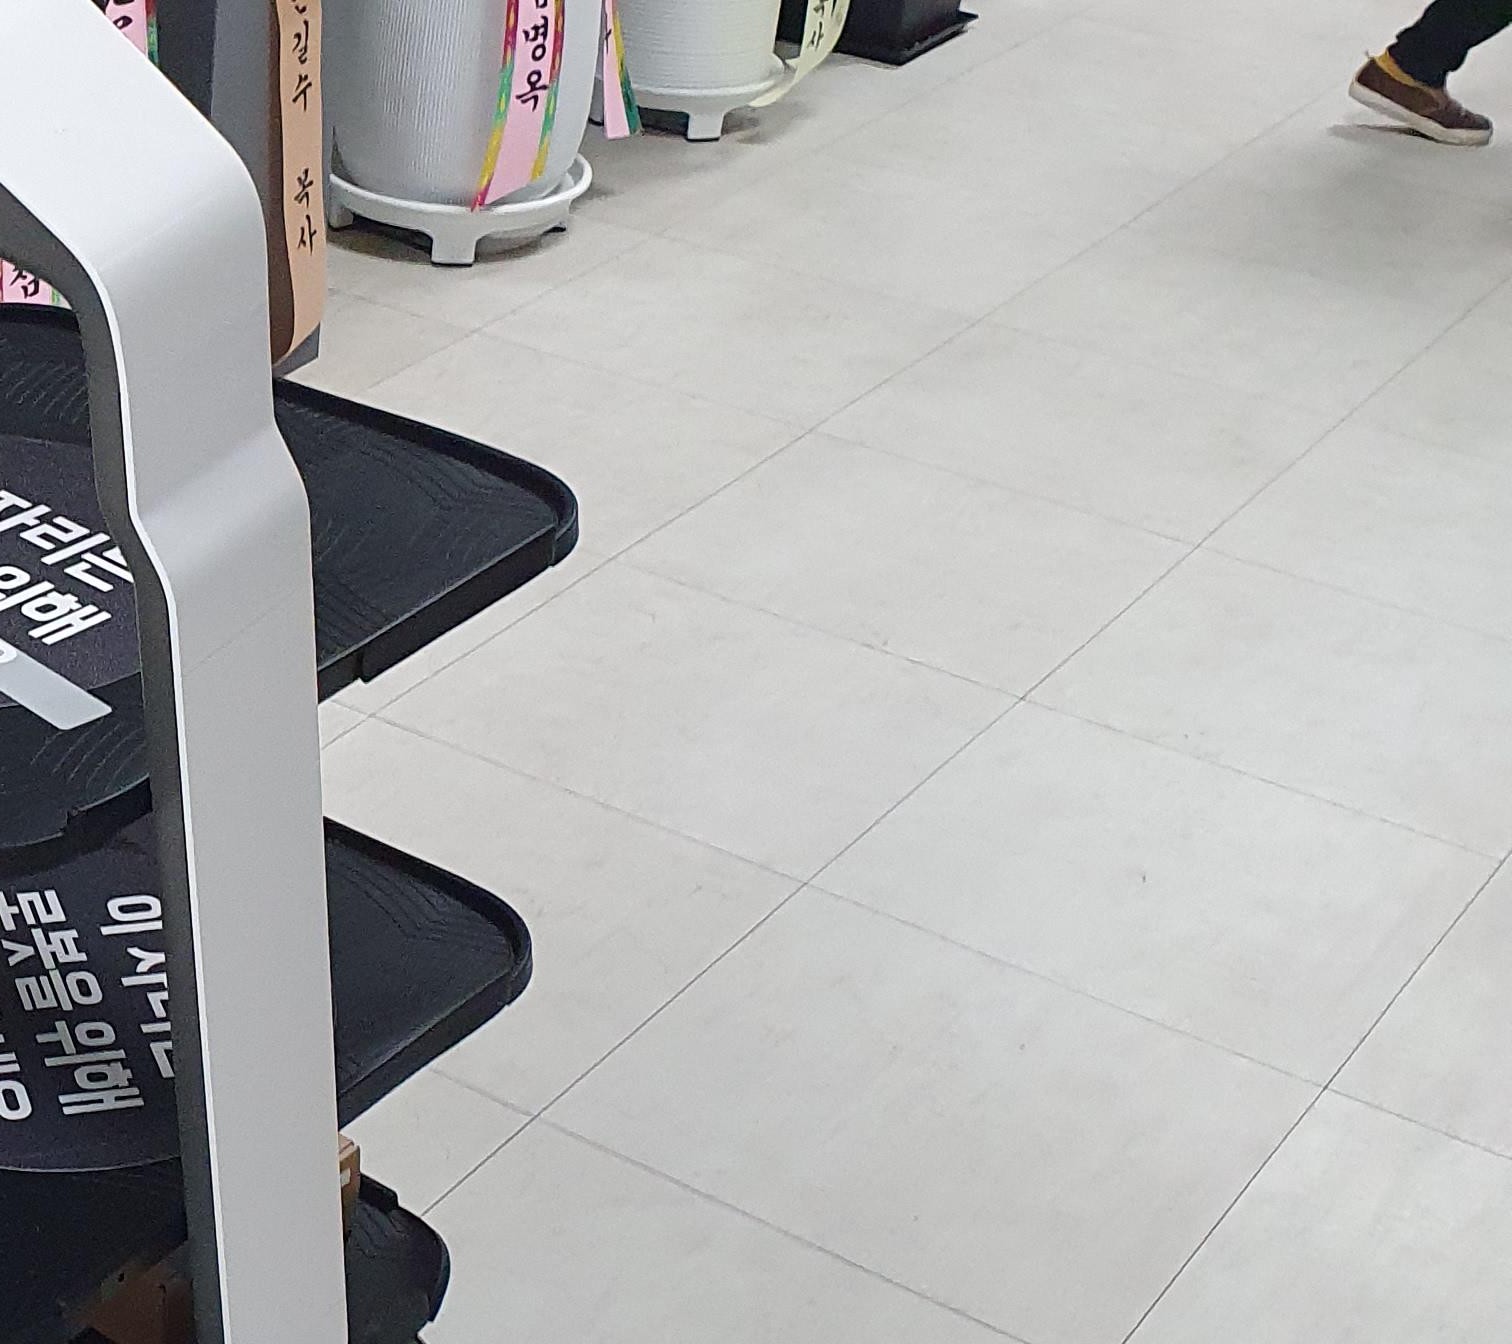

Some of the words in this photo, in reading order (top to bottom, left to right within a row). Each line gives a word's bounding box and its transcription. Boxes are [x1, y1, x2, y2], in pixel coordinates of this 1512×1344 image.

[293, 168, 317, 255] 목사
[100, 895, 163, 935] 이
[36, 1020, 144, 1115] 위해
